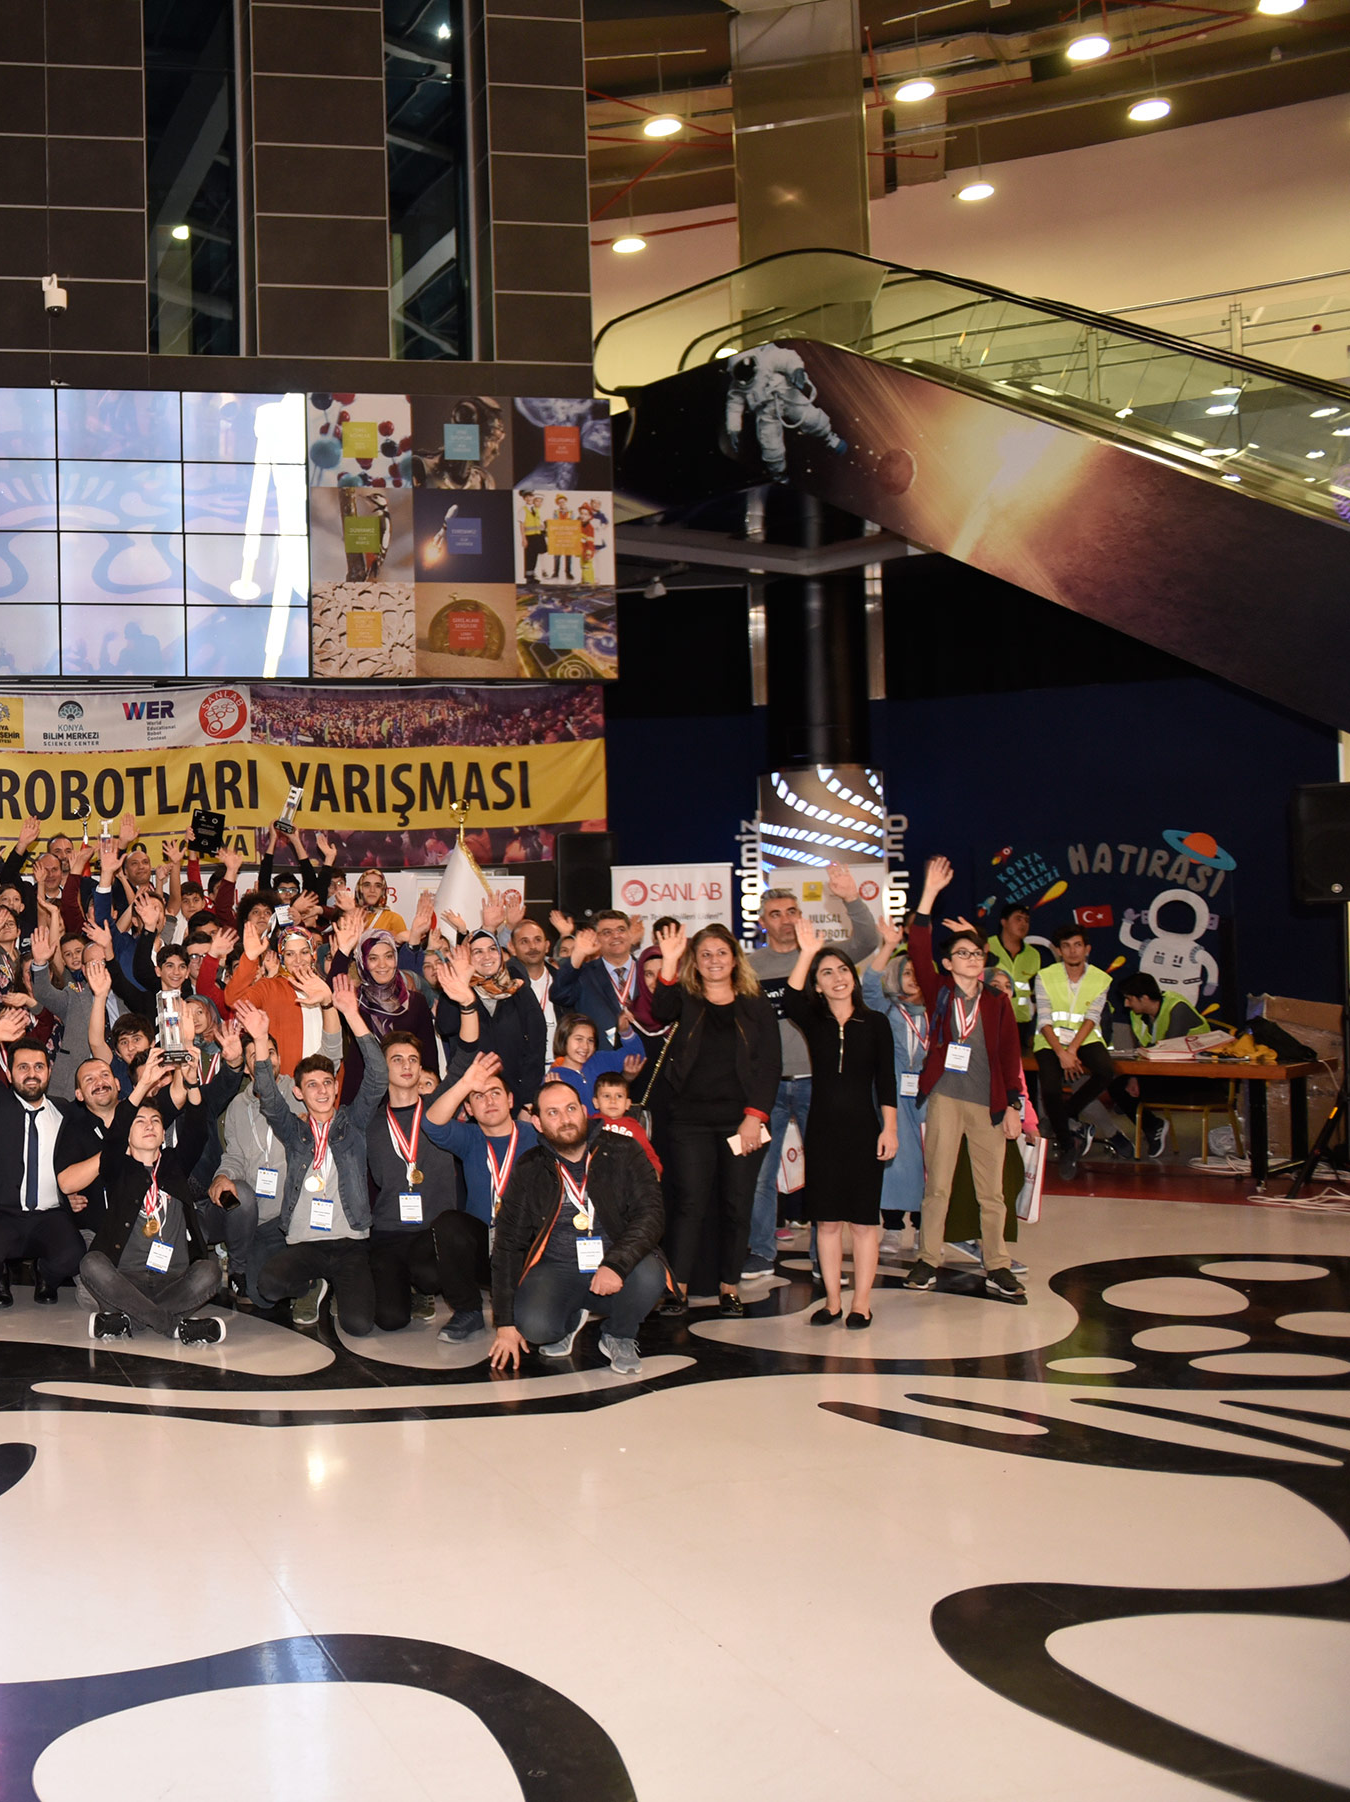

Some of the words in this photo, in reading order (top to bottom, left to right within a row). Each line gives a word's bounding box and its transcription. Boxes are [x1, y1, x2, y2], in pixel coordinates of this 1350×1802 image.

[122, 700, 174, 721] WER
[201, 690, 244, 710] SANLAB
[42, 732, 64, 740] BİLİM
[66, 730, 100, 740] MERKEZİ
[58, 724, 84, 732] KONYA
[281, 760, 532, 827] YARIŞMASI
[886, 814, 908, 862] Our
[996, 852, 1042, 883] KONYA
[1067, 842, 1226, 898] HATIRASI
[650, 882, 722, 902] SANLAB
[1005, 866, 1060, 904] MERKEZİ
